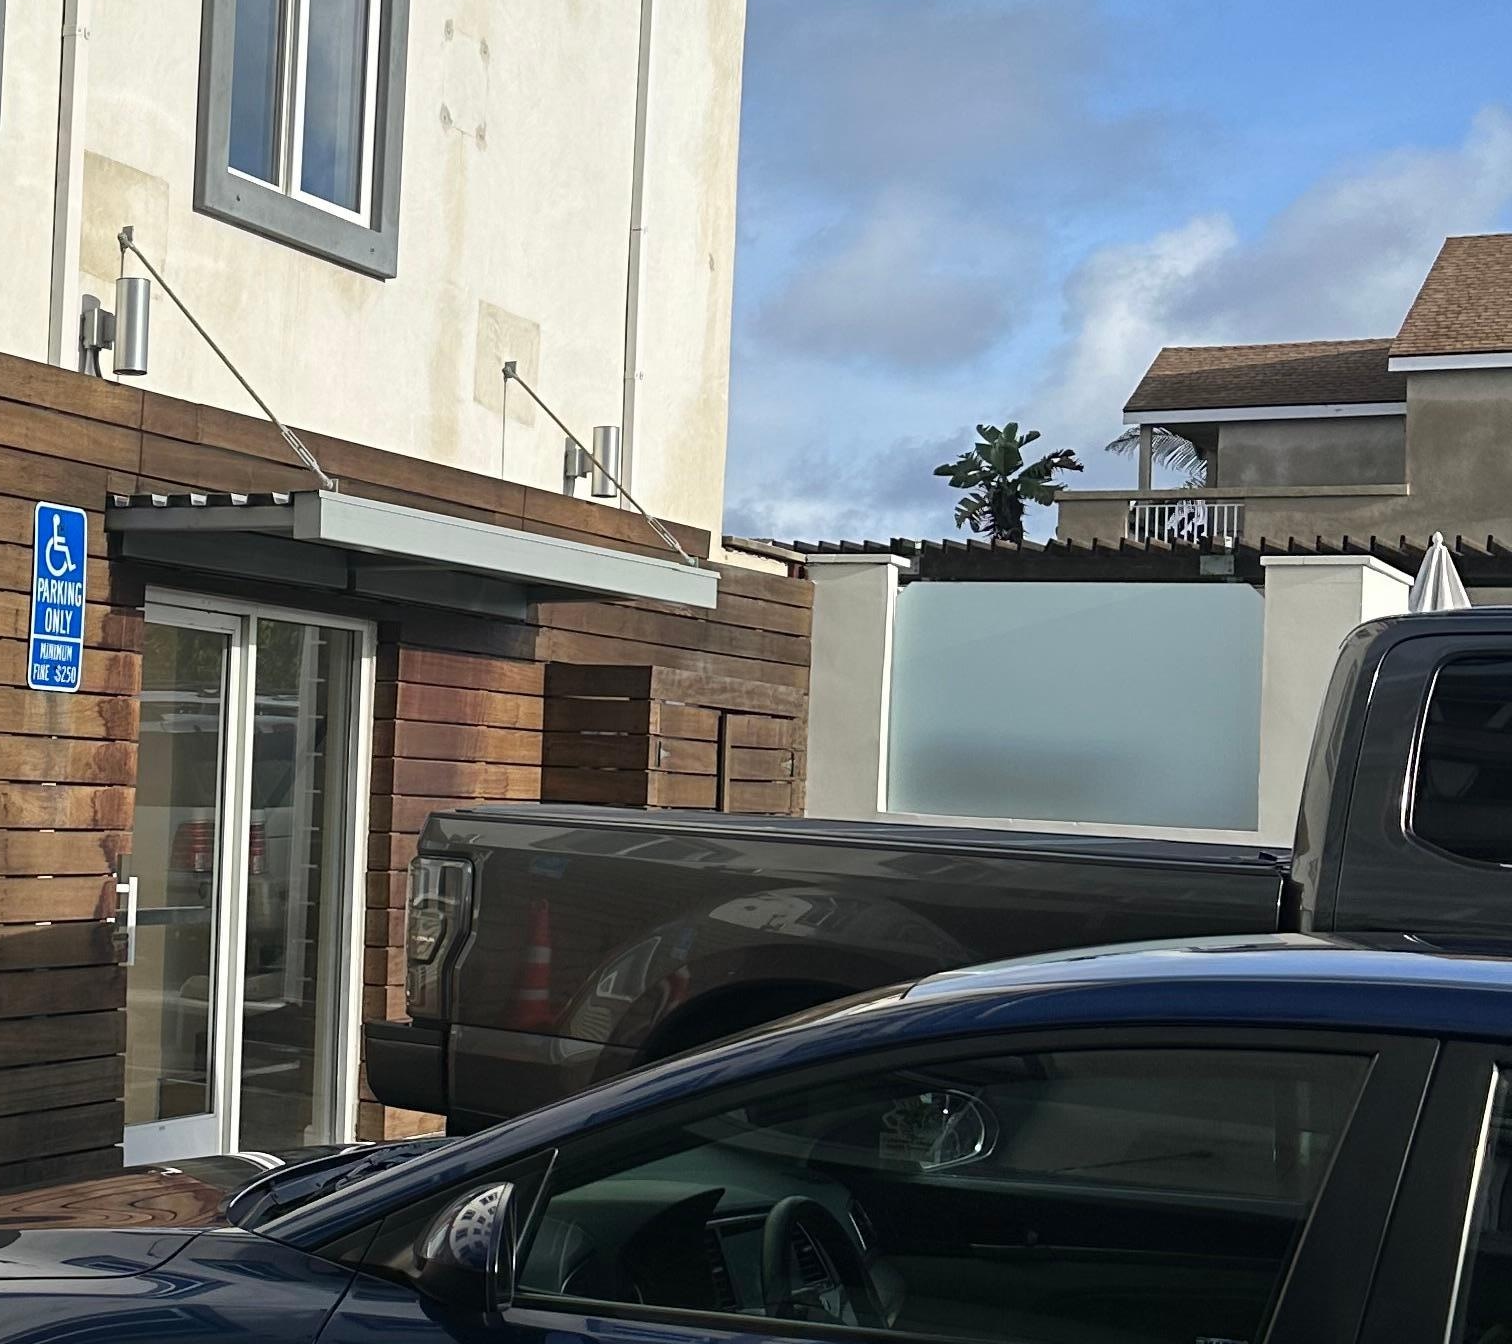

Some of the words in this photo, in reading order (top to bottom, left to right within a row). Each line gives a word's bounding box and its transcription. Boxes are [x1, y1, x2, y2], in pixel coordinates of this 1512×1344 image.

[37, 577, 82, 607] PARKING
[45, 607, 73, 635] ONLY
[40, 642, 73, 662] MINIMUM
[33, 663, 50, 681] FINE
[54, 664, 76, 684] $250
